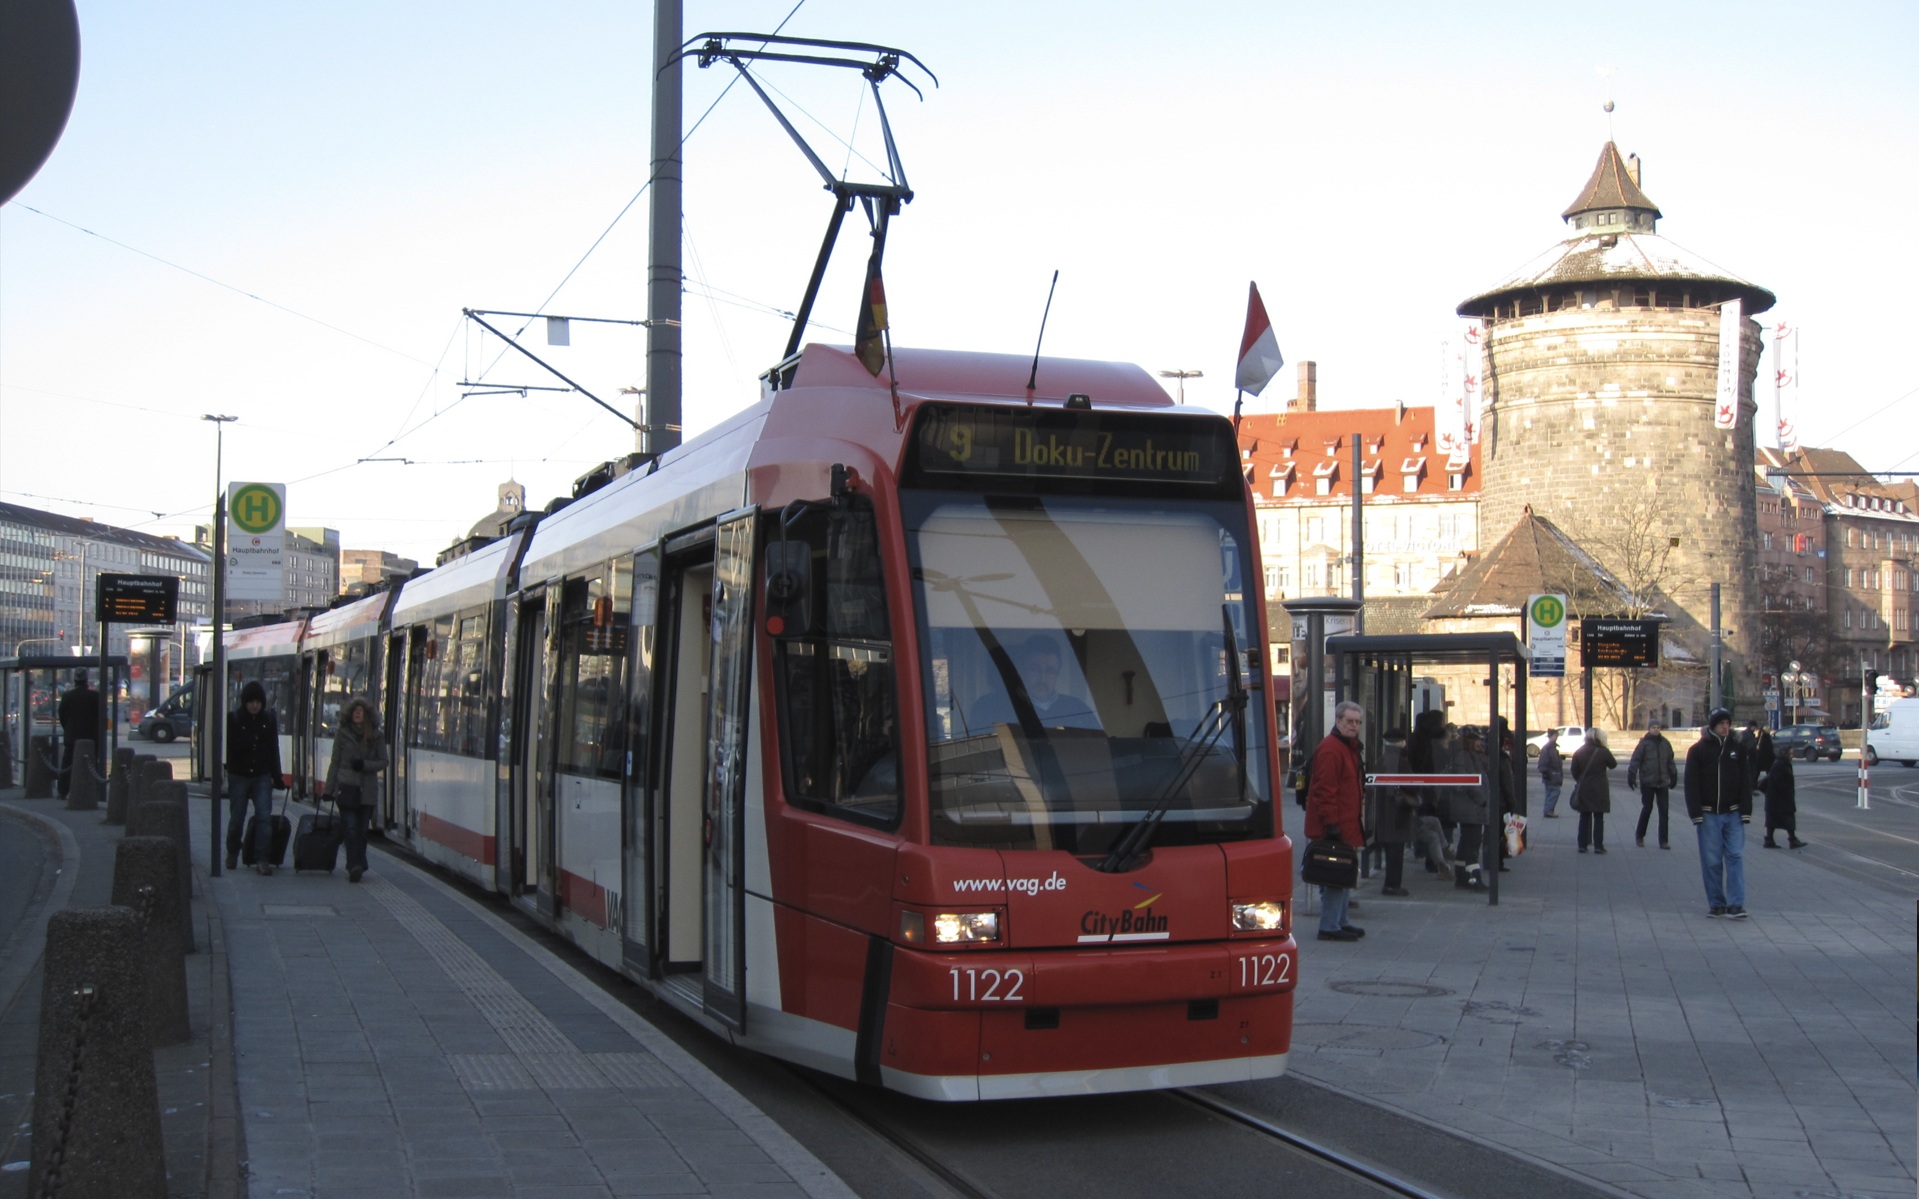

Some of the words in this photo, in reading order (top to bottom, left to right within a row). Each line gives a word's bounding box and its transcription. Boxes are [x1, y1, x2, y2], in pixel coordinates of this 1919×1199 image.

[949, 426, 973, 462] 9
[1014, 427, 1200, 472] Doku-Zentrum
[245, 495, 269, 522] H
[232, 547, 280, 555] Hauptbahnhof
[117, 579, 163, 587] Hauptbahnhof
[1540, 603, 1555, 620] H
[1597, 624, 1642, 632] Hauptbahnhof
[952, 871, 1067, 896] www.vag.de
[1080, 907, 1169, 941] CityBahn
[1239, 952, 1290, 988] 1122
[949, 968, 1024, 1001] 1122
